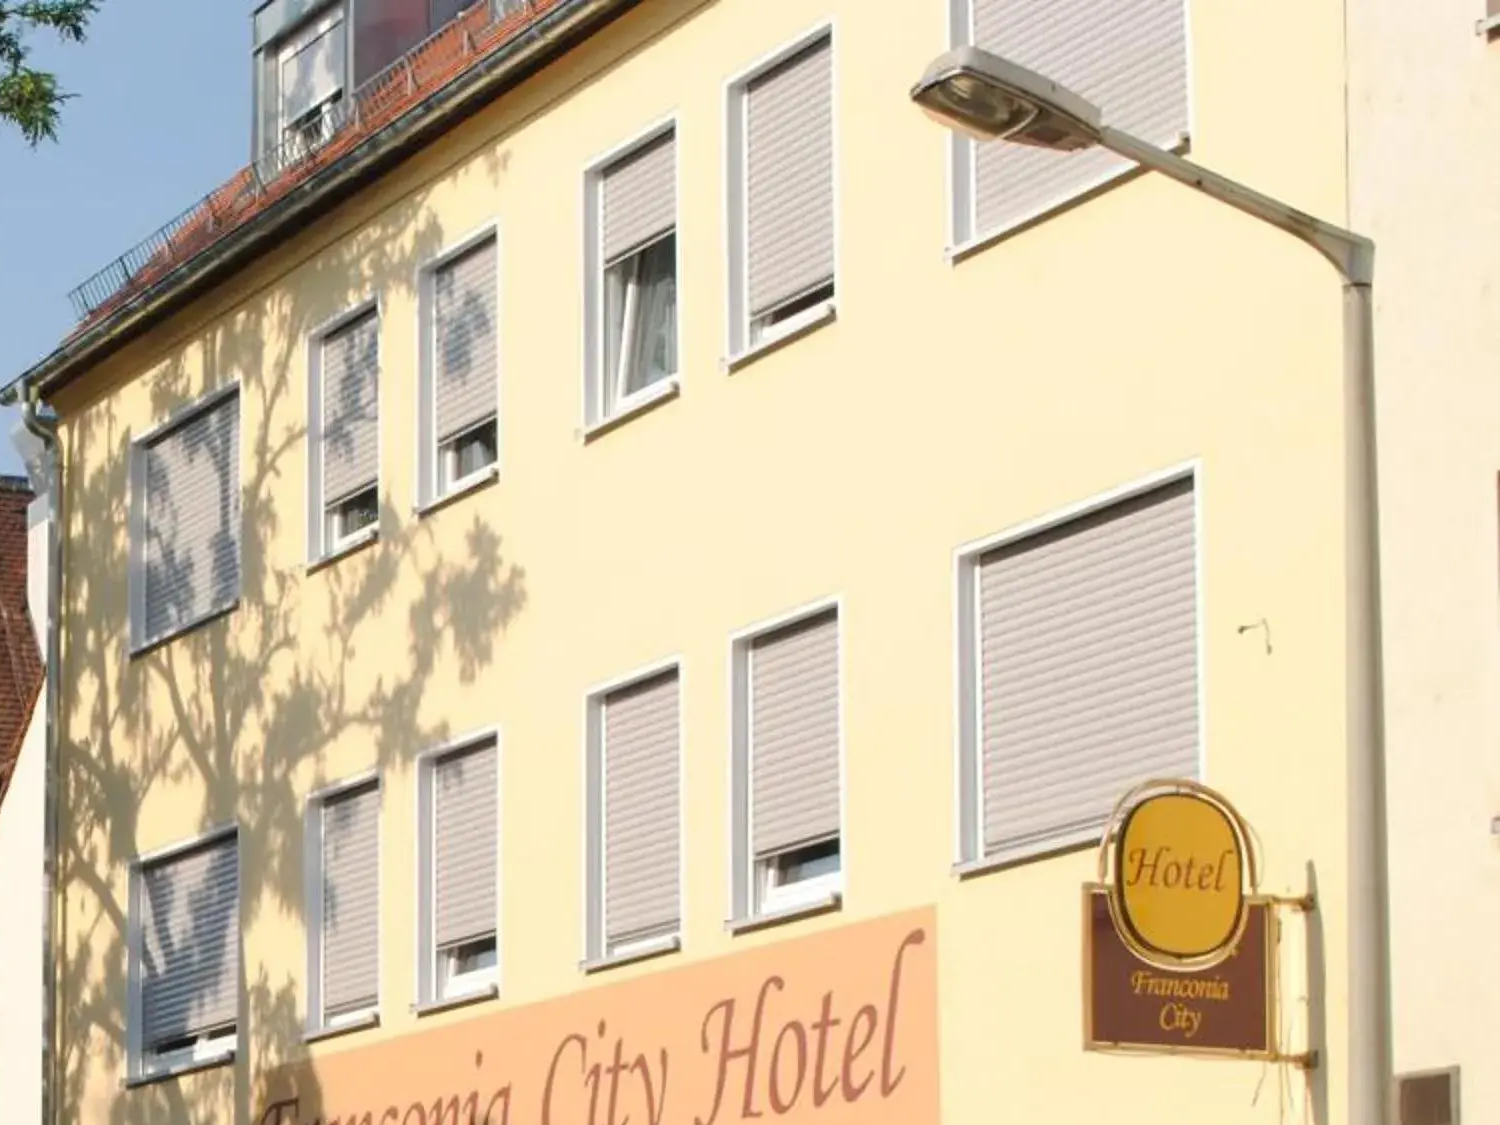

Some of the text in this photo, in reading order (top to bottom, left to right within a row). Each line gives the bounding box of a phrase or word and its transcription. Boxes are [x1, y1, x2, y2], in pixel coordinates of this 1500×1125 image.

[1126, 847, 1234, 893] Hotel
[1131, 970, 1230, 1000] Franconia
[1158, 1002, 1202, 1039] City
